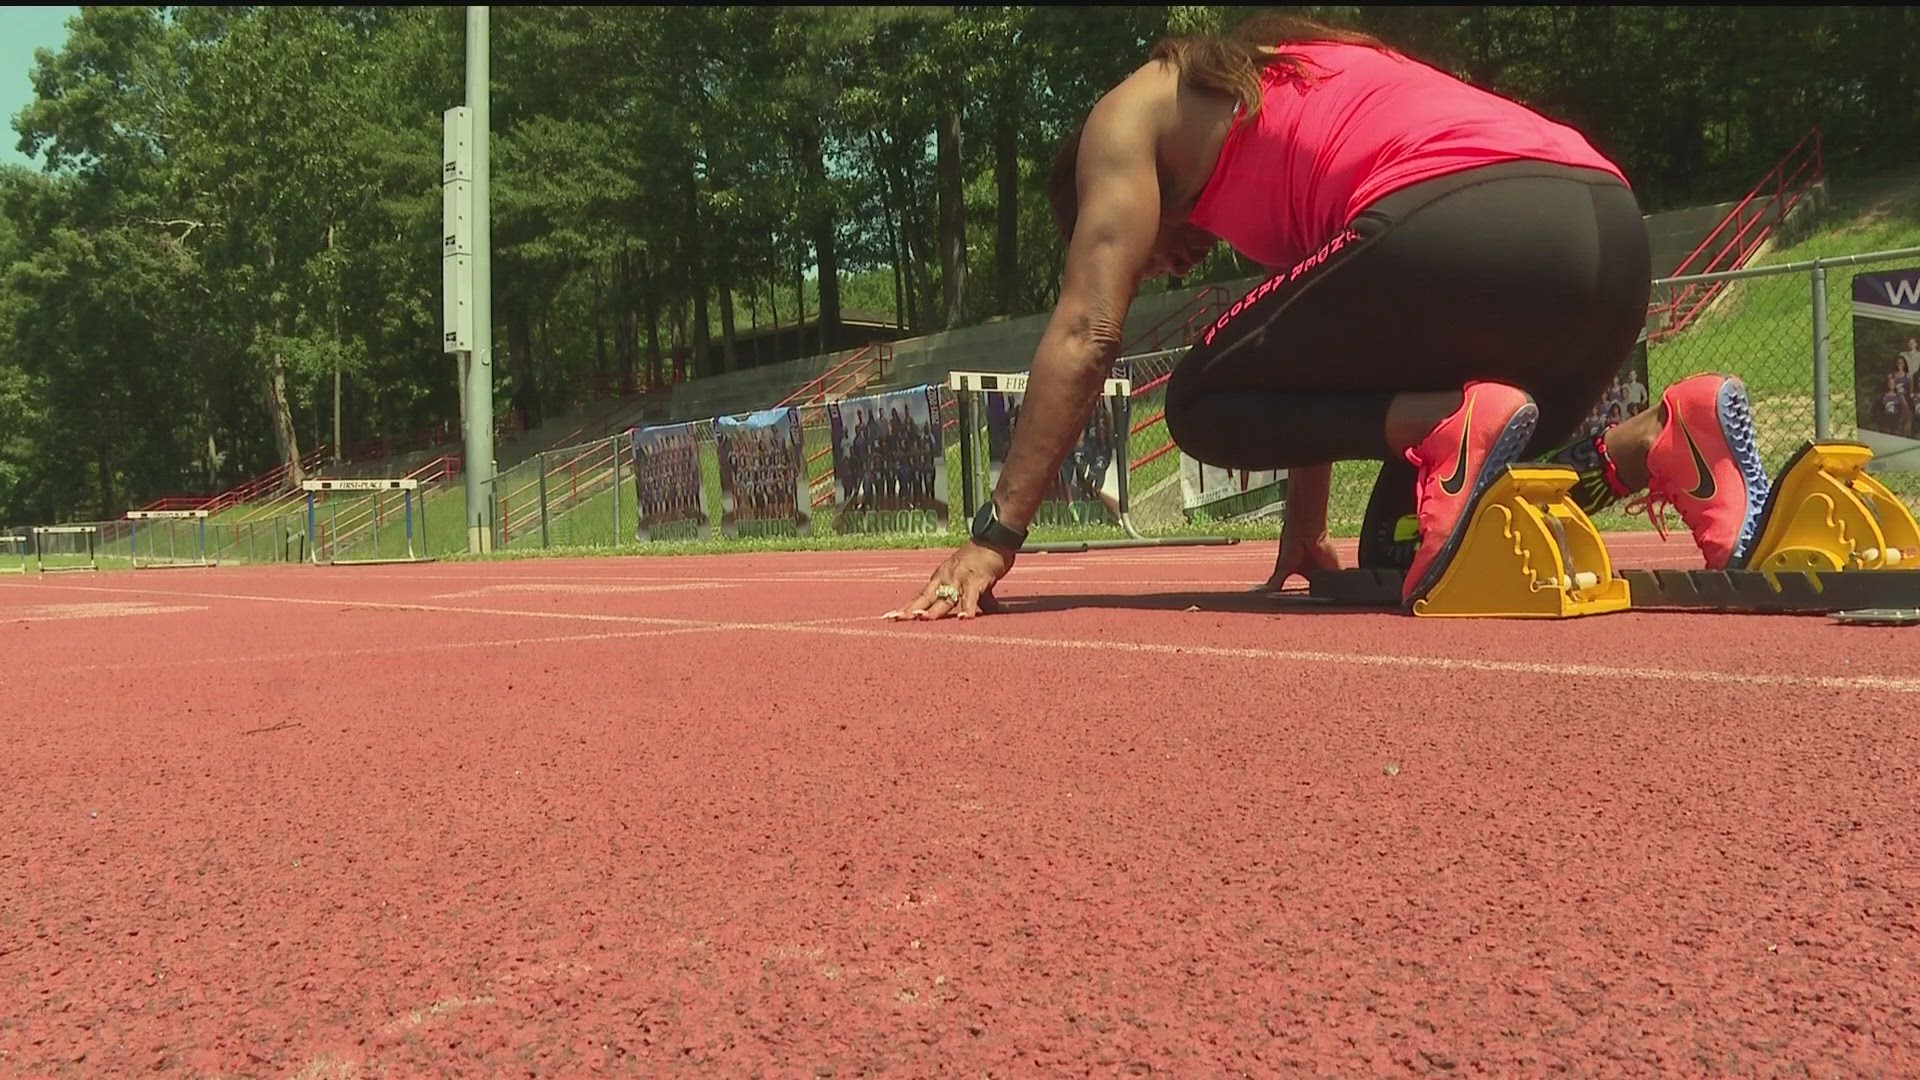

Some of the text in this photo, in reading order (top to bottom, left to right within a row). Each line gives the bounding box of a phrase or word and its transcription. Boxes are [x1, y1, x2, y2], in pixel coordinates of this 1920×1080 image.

[1203, 272, 1287, 346] ARMOUR
[1005, 377, 1026, 390] FIR
[842, 509, 938, 534] WARRIORS
